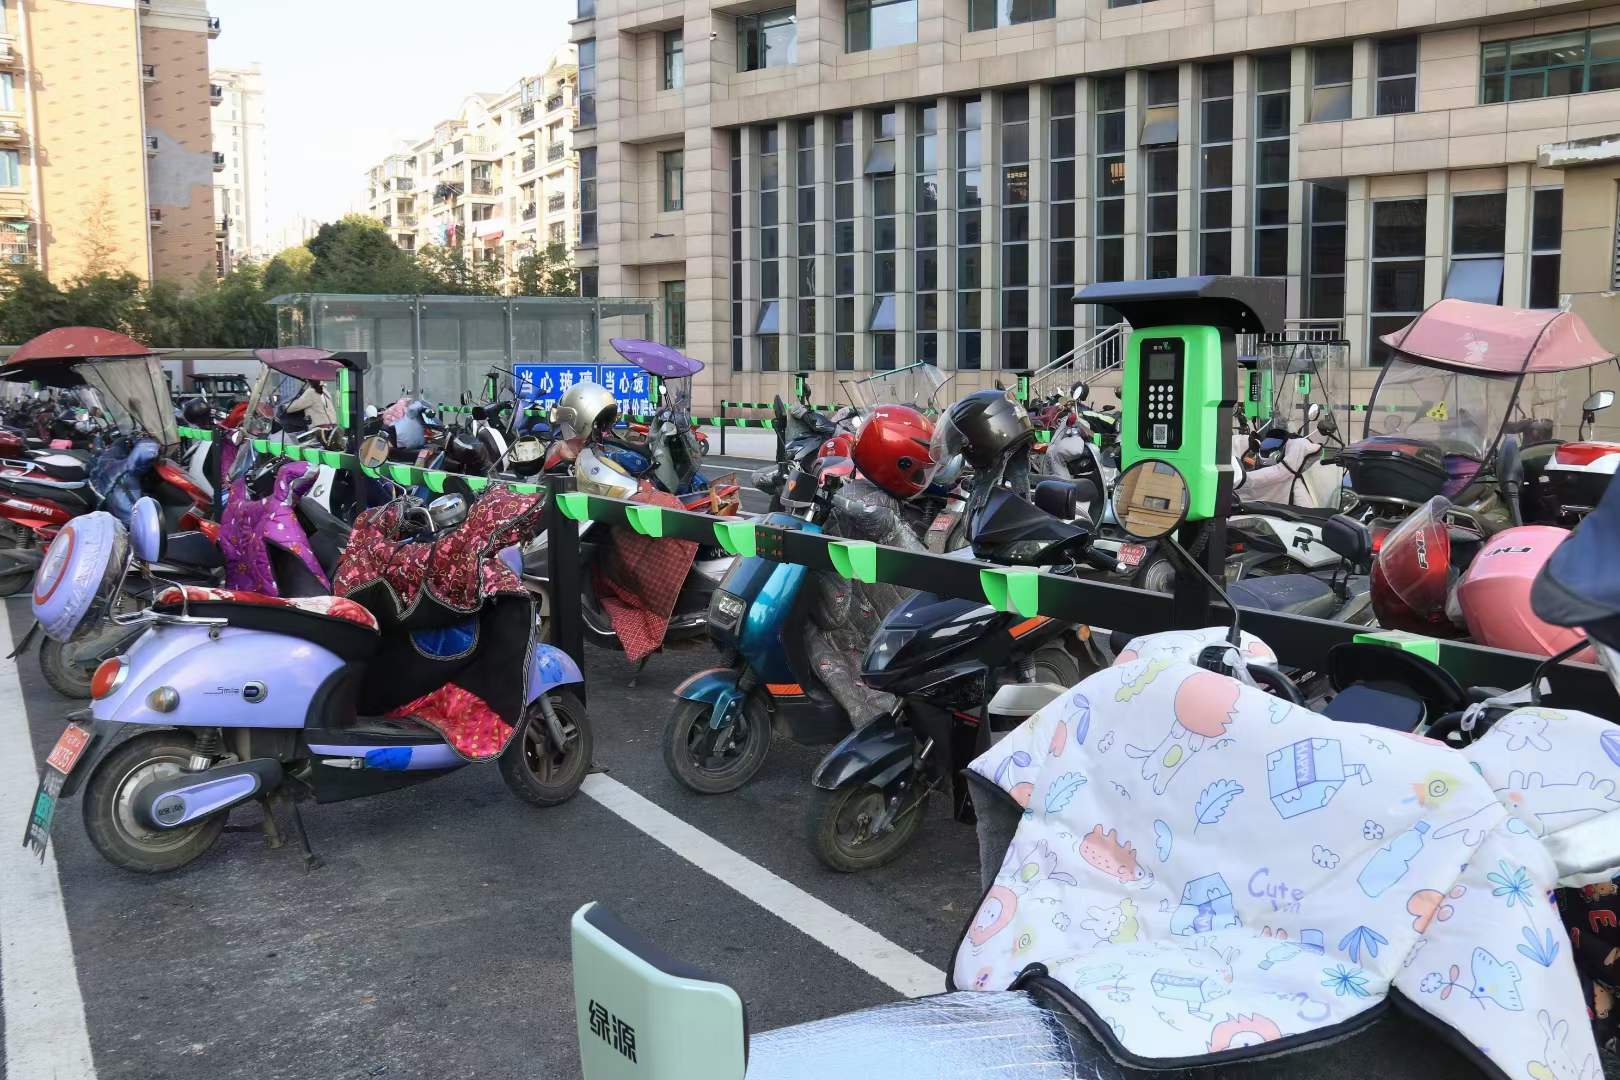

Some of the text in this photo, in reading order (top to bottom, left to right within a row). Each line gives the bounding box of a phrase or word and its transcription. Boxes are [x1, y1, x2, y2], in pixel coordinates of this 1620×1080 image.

[604, 370, 649, 394] 当心玻
[1248, 867, 1304, 901] Cute
[588, 999, 637, 1064] 绿源
